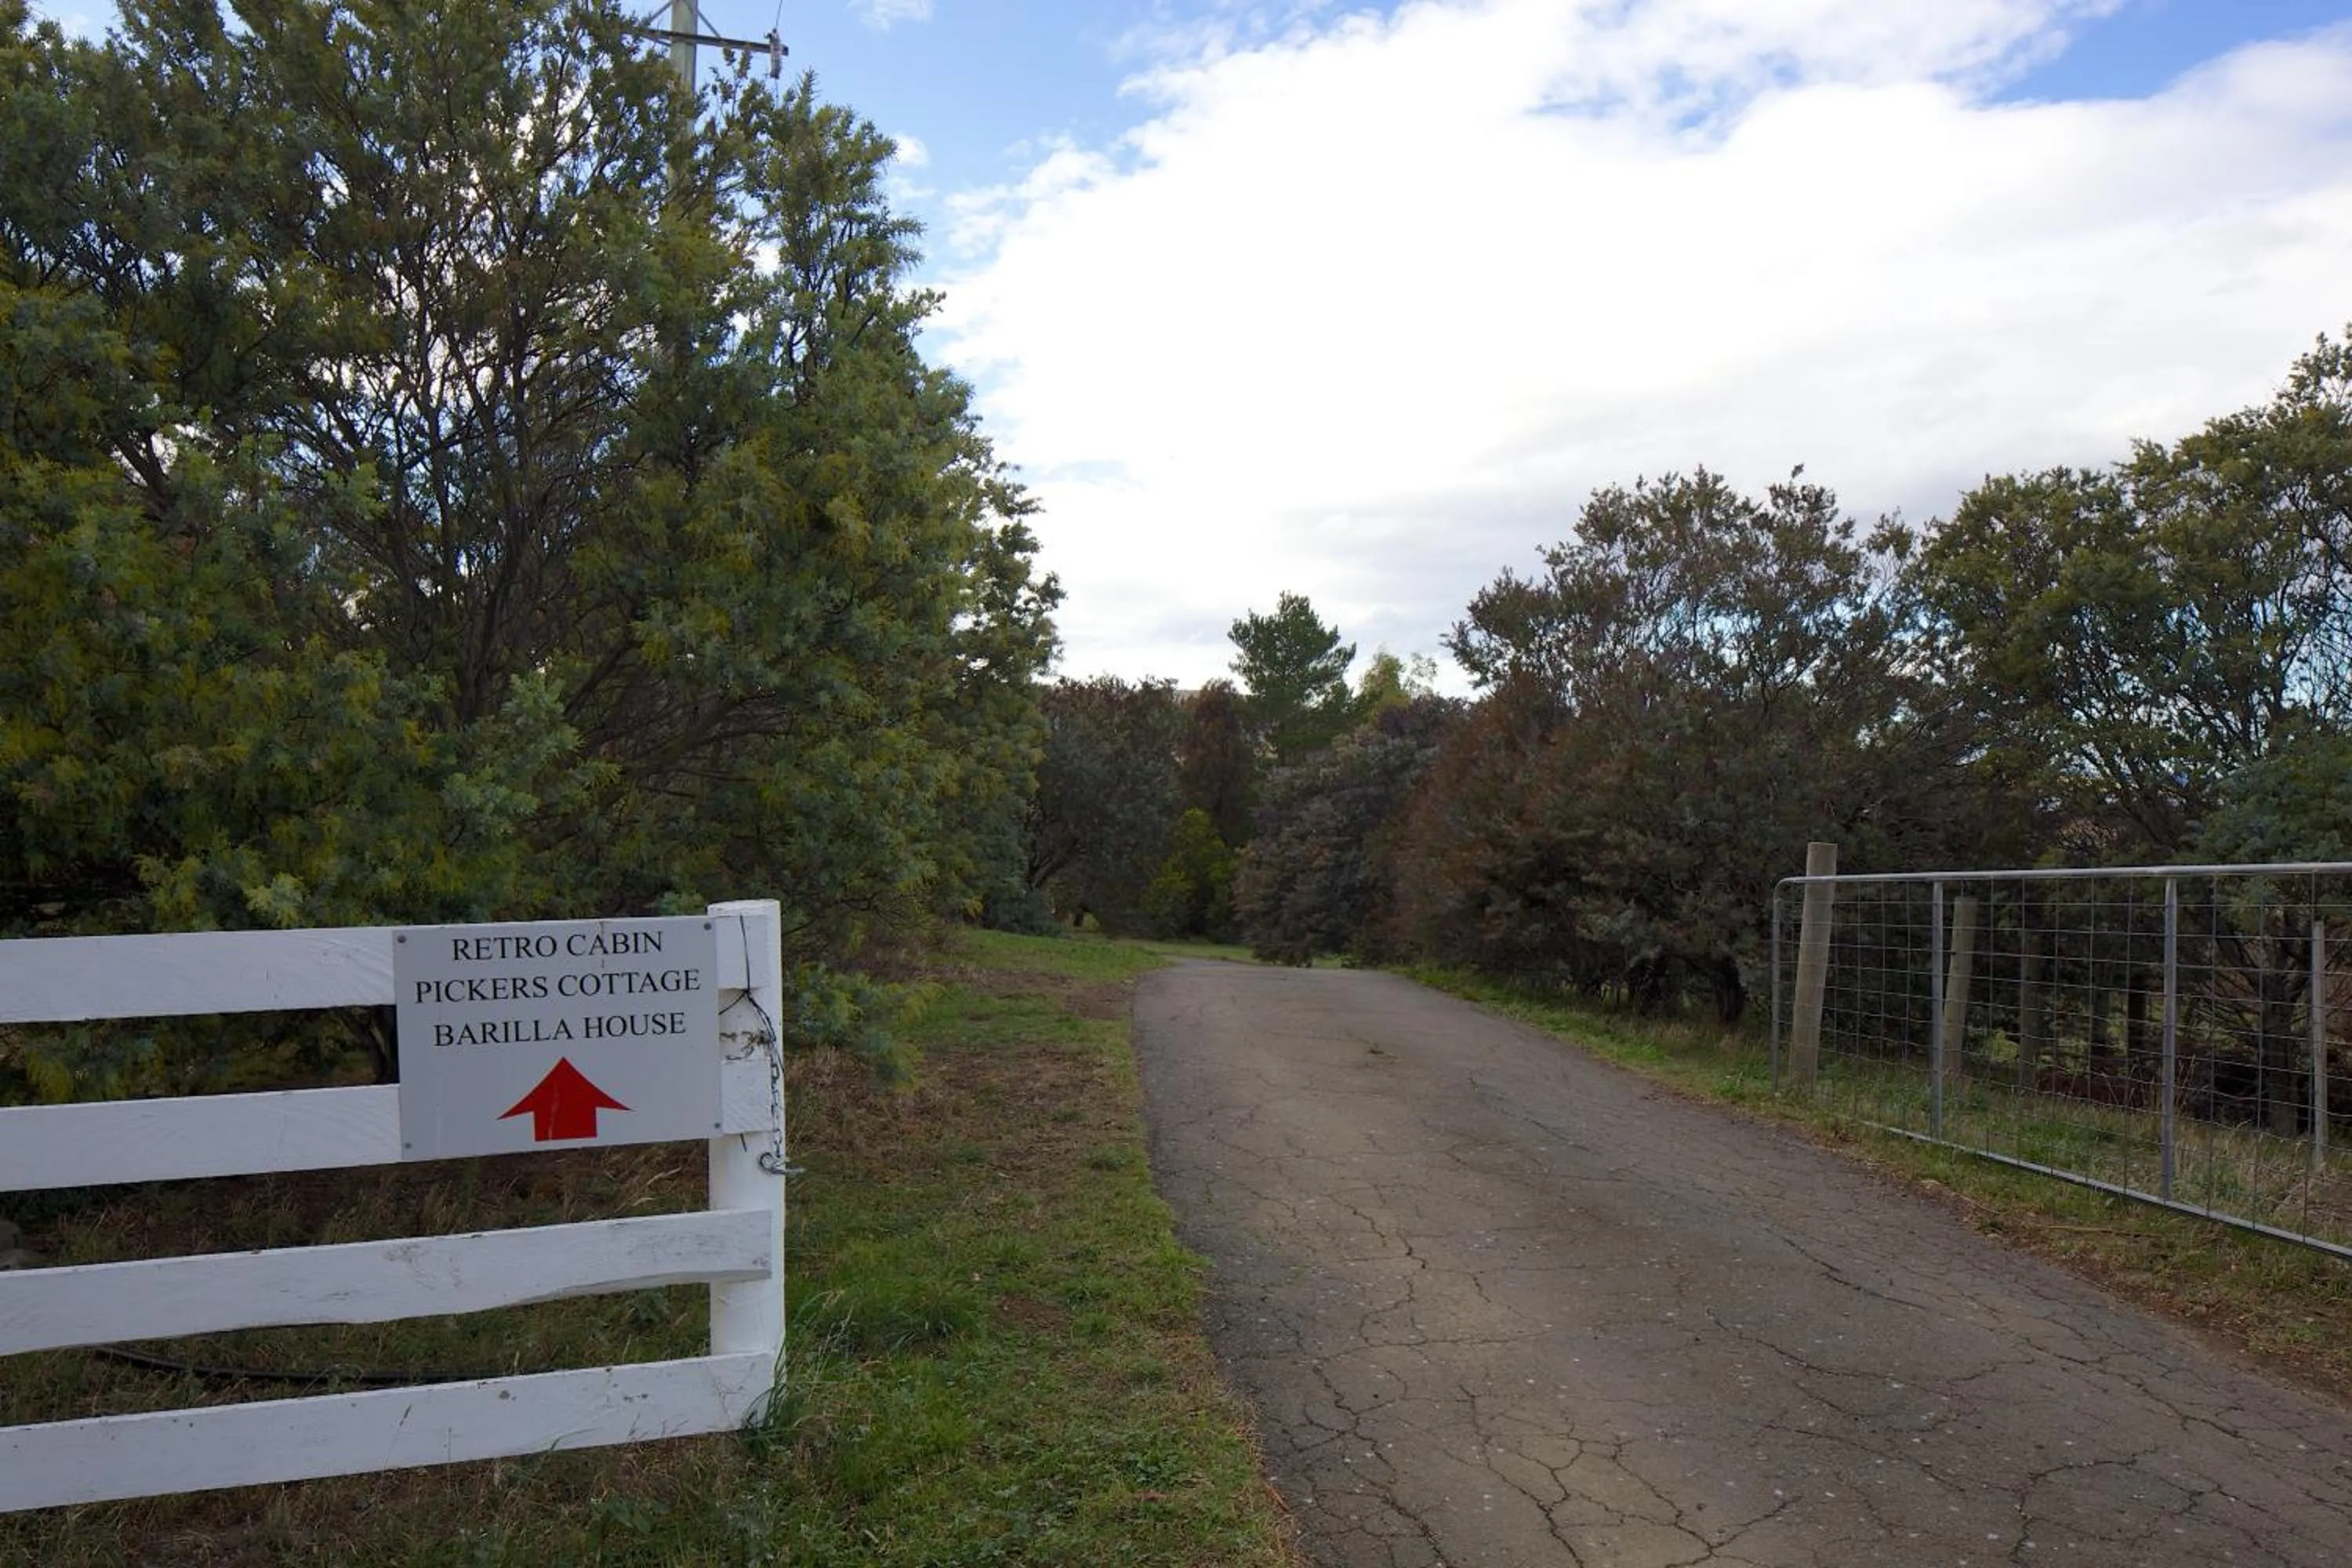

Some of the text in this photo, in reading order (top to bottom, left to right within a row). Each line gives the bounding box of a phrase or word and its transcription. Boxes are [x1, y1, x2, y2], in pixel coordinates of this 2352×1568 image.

[452, 931, 662, 961] RETRO CABIN
[414, 969, 701, 1004] PICKERS COTTAGE
[433, 1012, 687, 1047] BARILLA HOUSE
